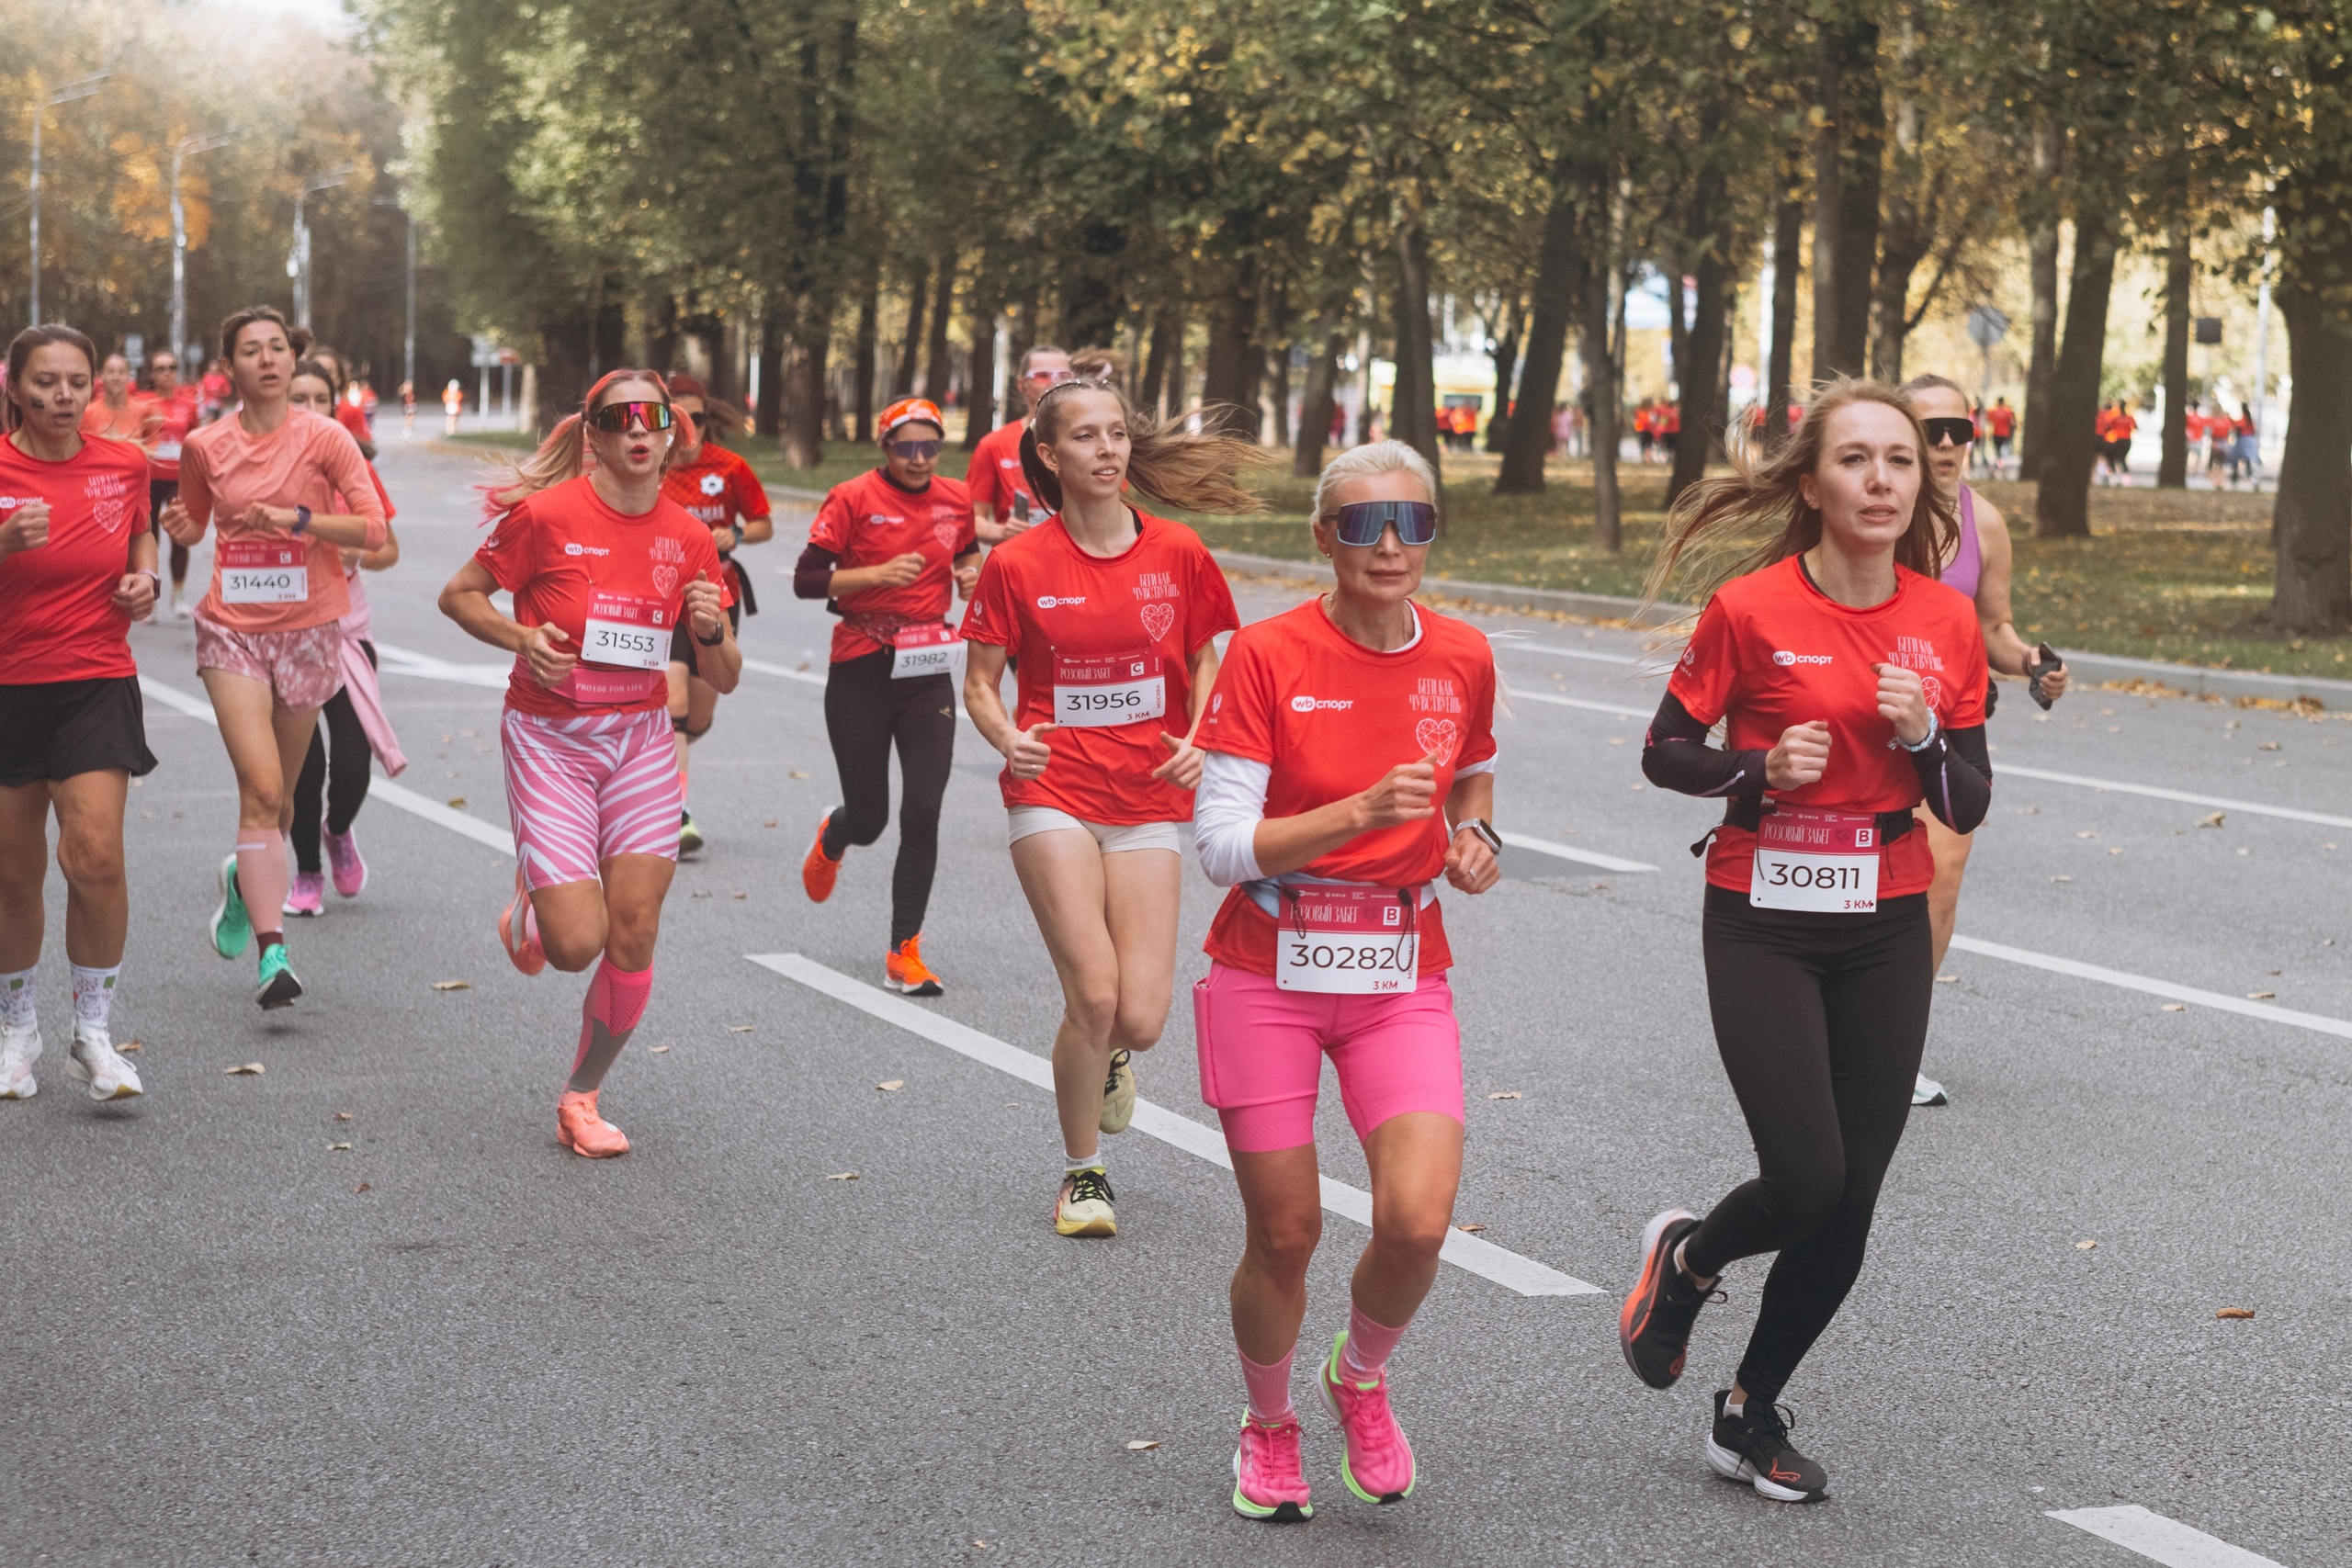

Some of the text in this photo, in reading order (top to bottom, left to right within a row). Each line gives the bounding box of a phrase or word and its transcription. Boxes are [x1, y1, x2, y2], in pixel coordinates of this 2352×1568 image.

[584, 547, 609, 557] спорт
[230, 573, 290, 590] 31440
[1139, 573, 1158, 587] БЕГИ
[1038, 597, 1086, 607] wb спорт
[654, 612, 661, 621] C
[596, 630, 654, 653] 31553
[1897, 636, 1918, 653] БЕГИ
[901, 652, 947, 668] 31982
[1774, 652, 1833, 665] wb спорт
[1133, 664, 1141, 672] C
[1418, 678, 1453, 696] БЕГИ КАК
[1067, 691, 1141, 711] 31956
[1294, 697, 1353, 711] wb спорт
[1409, 694, 1461, 713] ЧУВСТВУЕШЬ
[1135, 711, 1149, 719] КМ
[1764, 823, 1832, 844] РОЗОВЫЙ ЗАБЕГ
[1859, 829, 1870, 842] B
[1769, 863, 1860, 889] 30811
[1844, 900, 1871, 909] 3 КМ
[1334, 906, 1359, 923] ЗАБЕГ
[1387, 908, 1397, 920] B
[1290, 943, 1395, 970] 30282
[1373, 980, 1397, 990] 3 КМ
